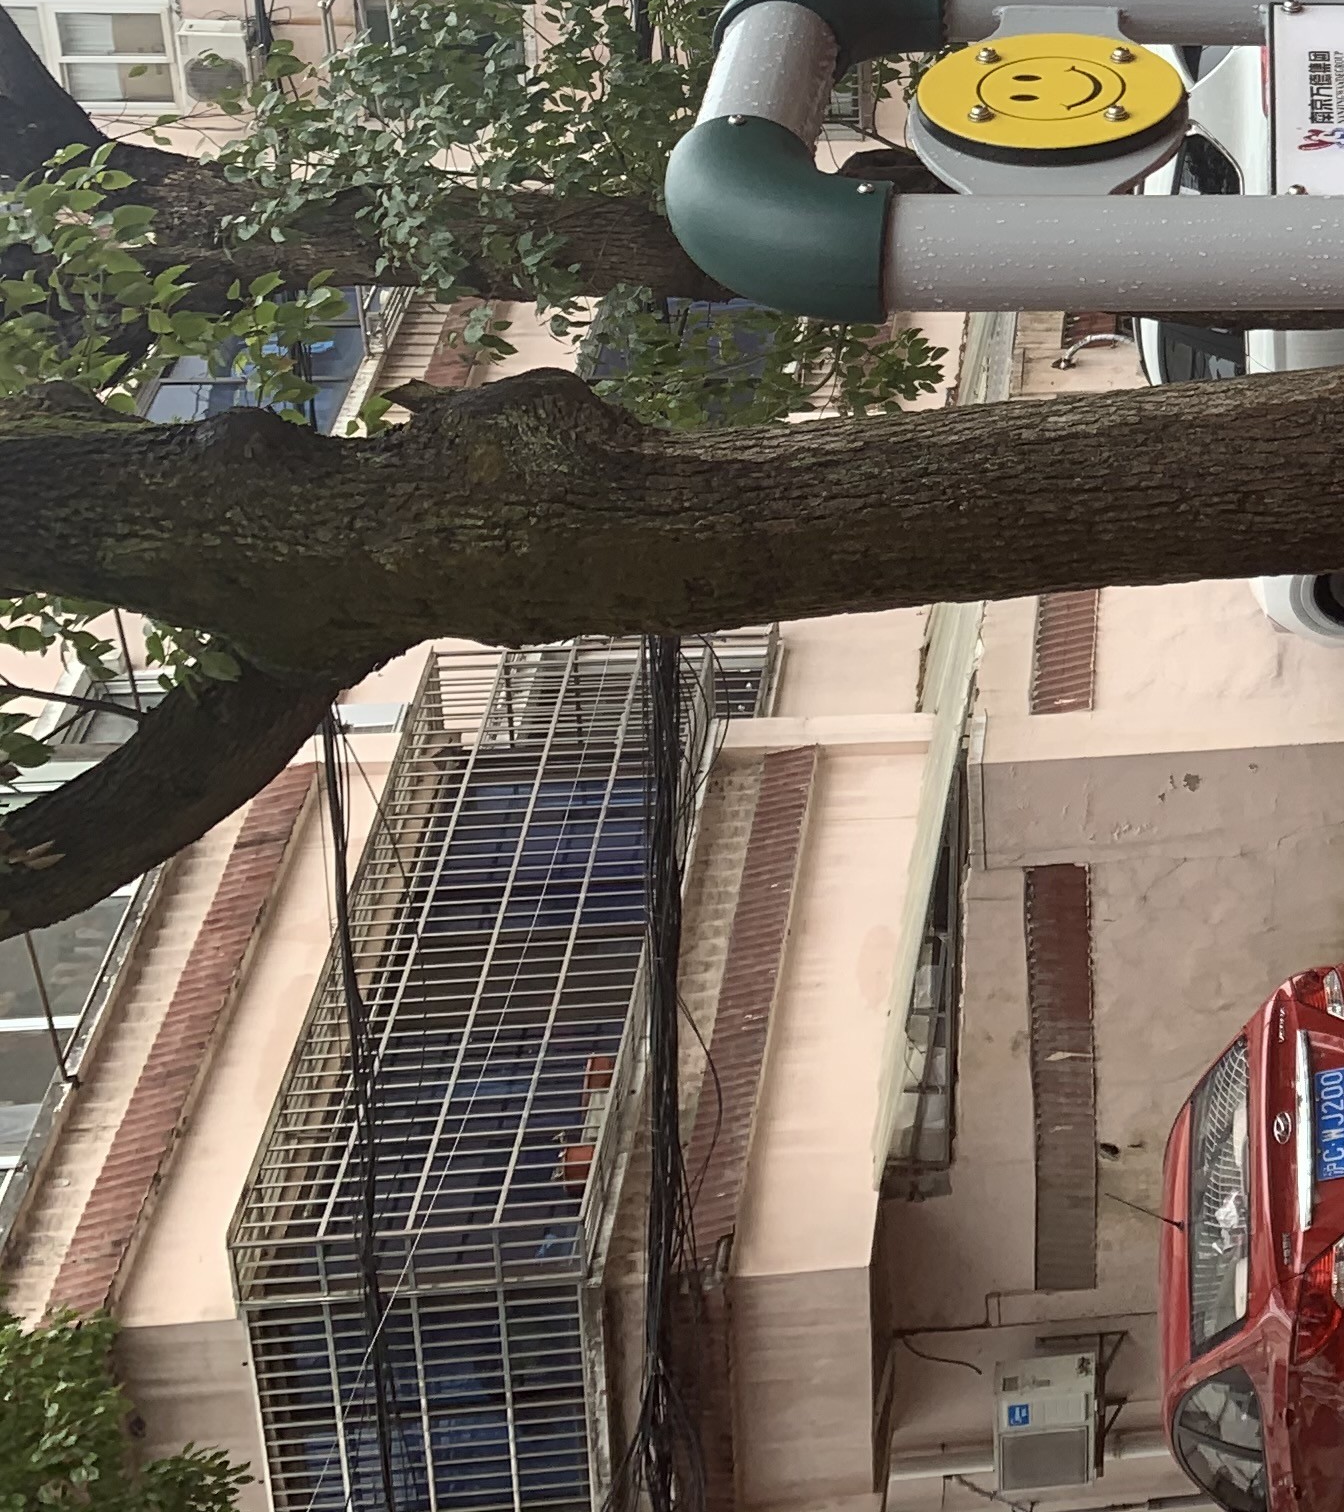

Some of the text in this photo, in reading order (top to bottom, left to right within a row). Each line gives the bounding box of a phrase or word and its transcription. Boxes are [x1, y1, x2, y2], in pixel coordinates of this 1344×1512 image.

[1306, 51, 1335, 125] 南京万德集团
